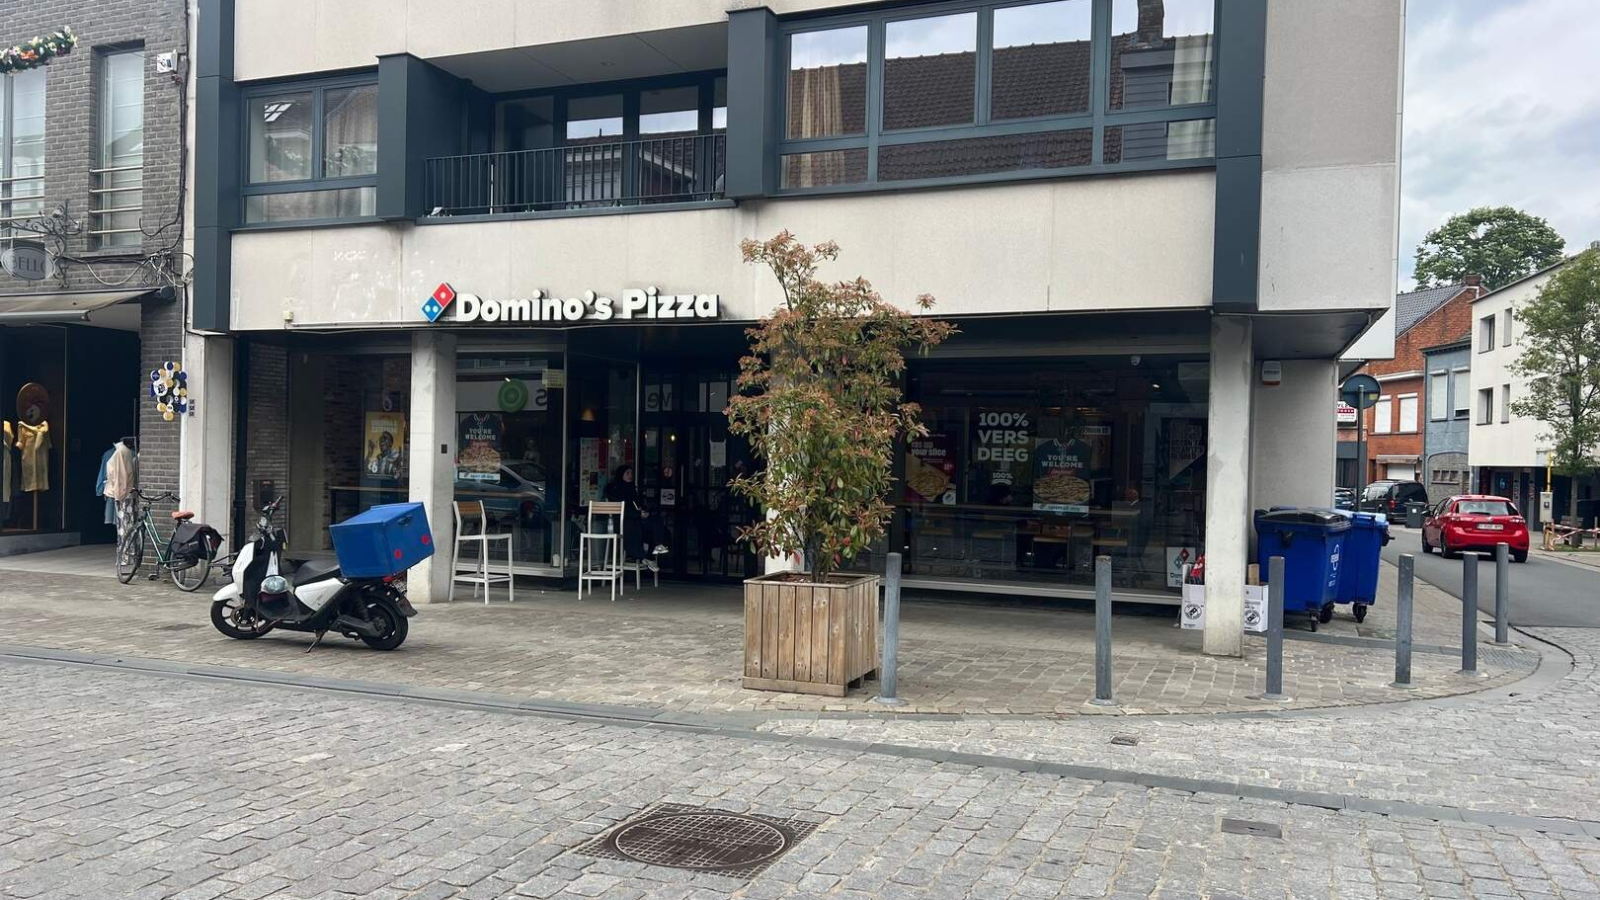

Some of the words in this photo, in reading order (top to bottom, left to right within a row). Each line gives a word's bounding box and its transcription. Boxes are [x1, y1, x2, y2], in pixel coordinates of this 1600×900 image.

[455, 288, 614, 322] Domino's
[622, 285, 718, 319] Pizza
[979, 412, 1029, 427] 100%
[978, 430, 1029, 445] VERS
[911, 449, 928, 457] your
[977, 447, 1029, 462] DEEG
[1047, 454, 1078, 462] YOU'RE
[1042, 460, 1084, 469] WELCOME
